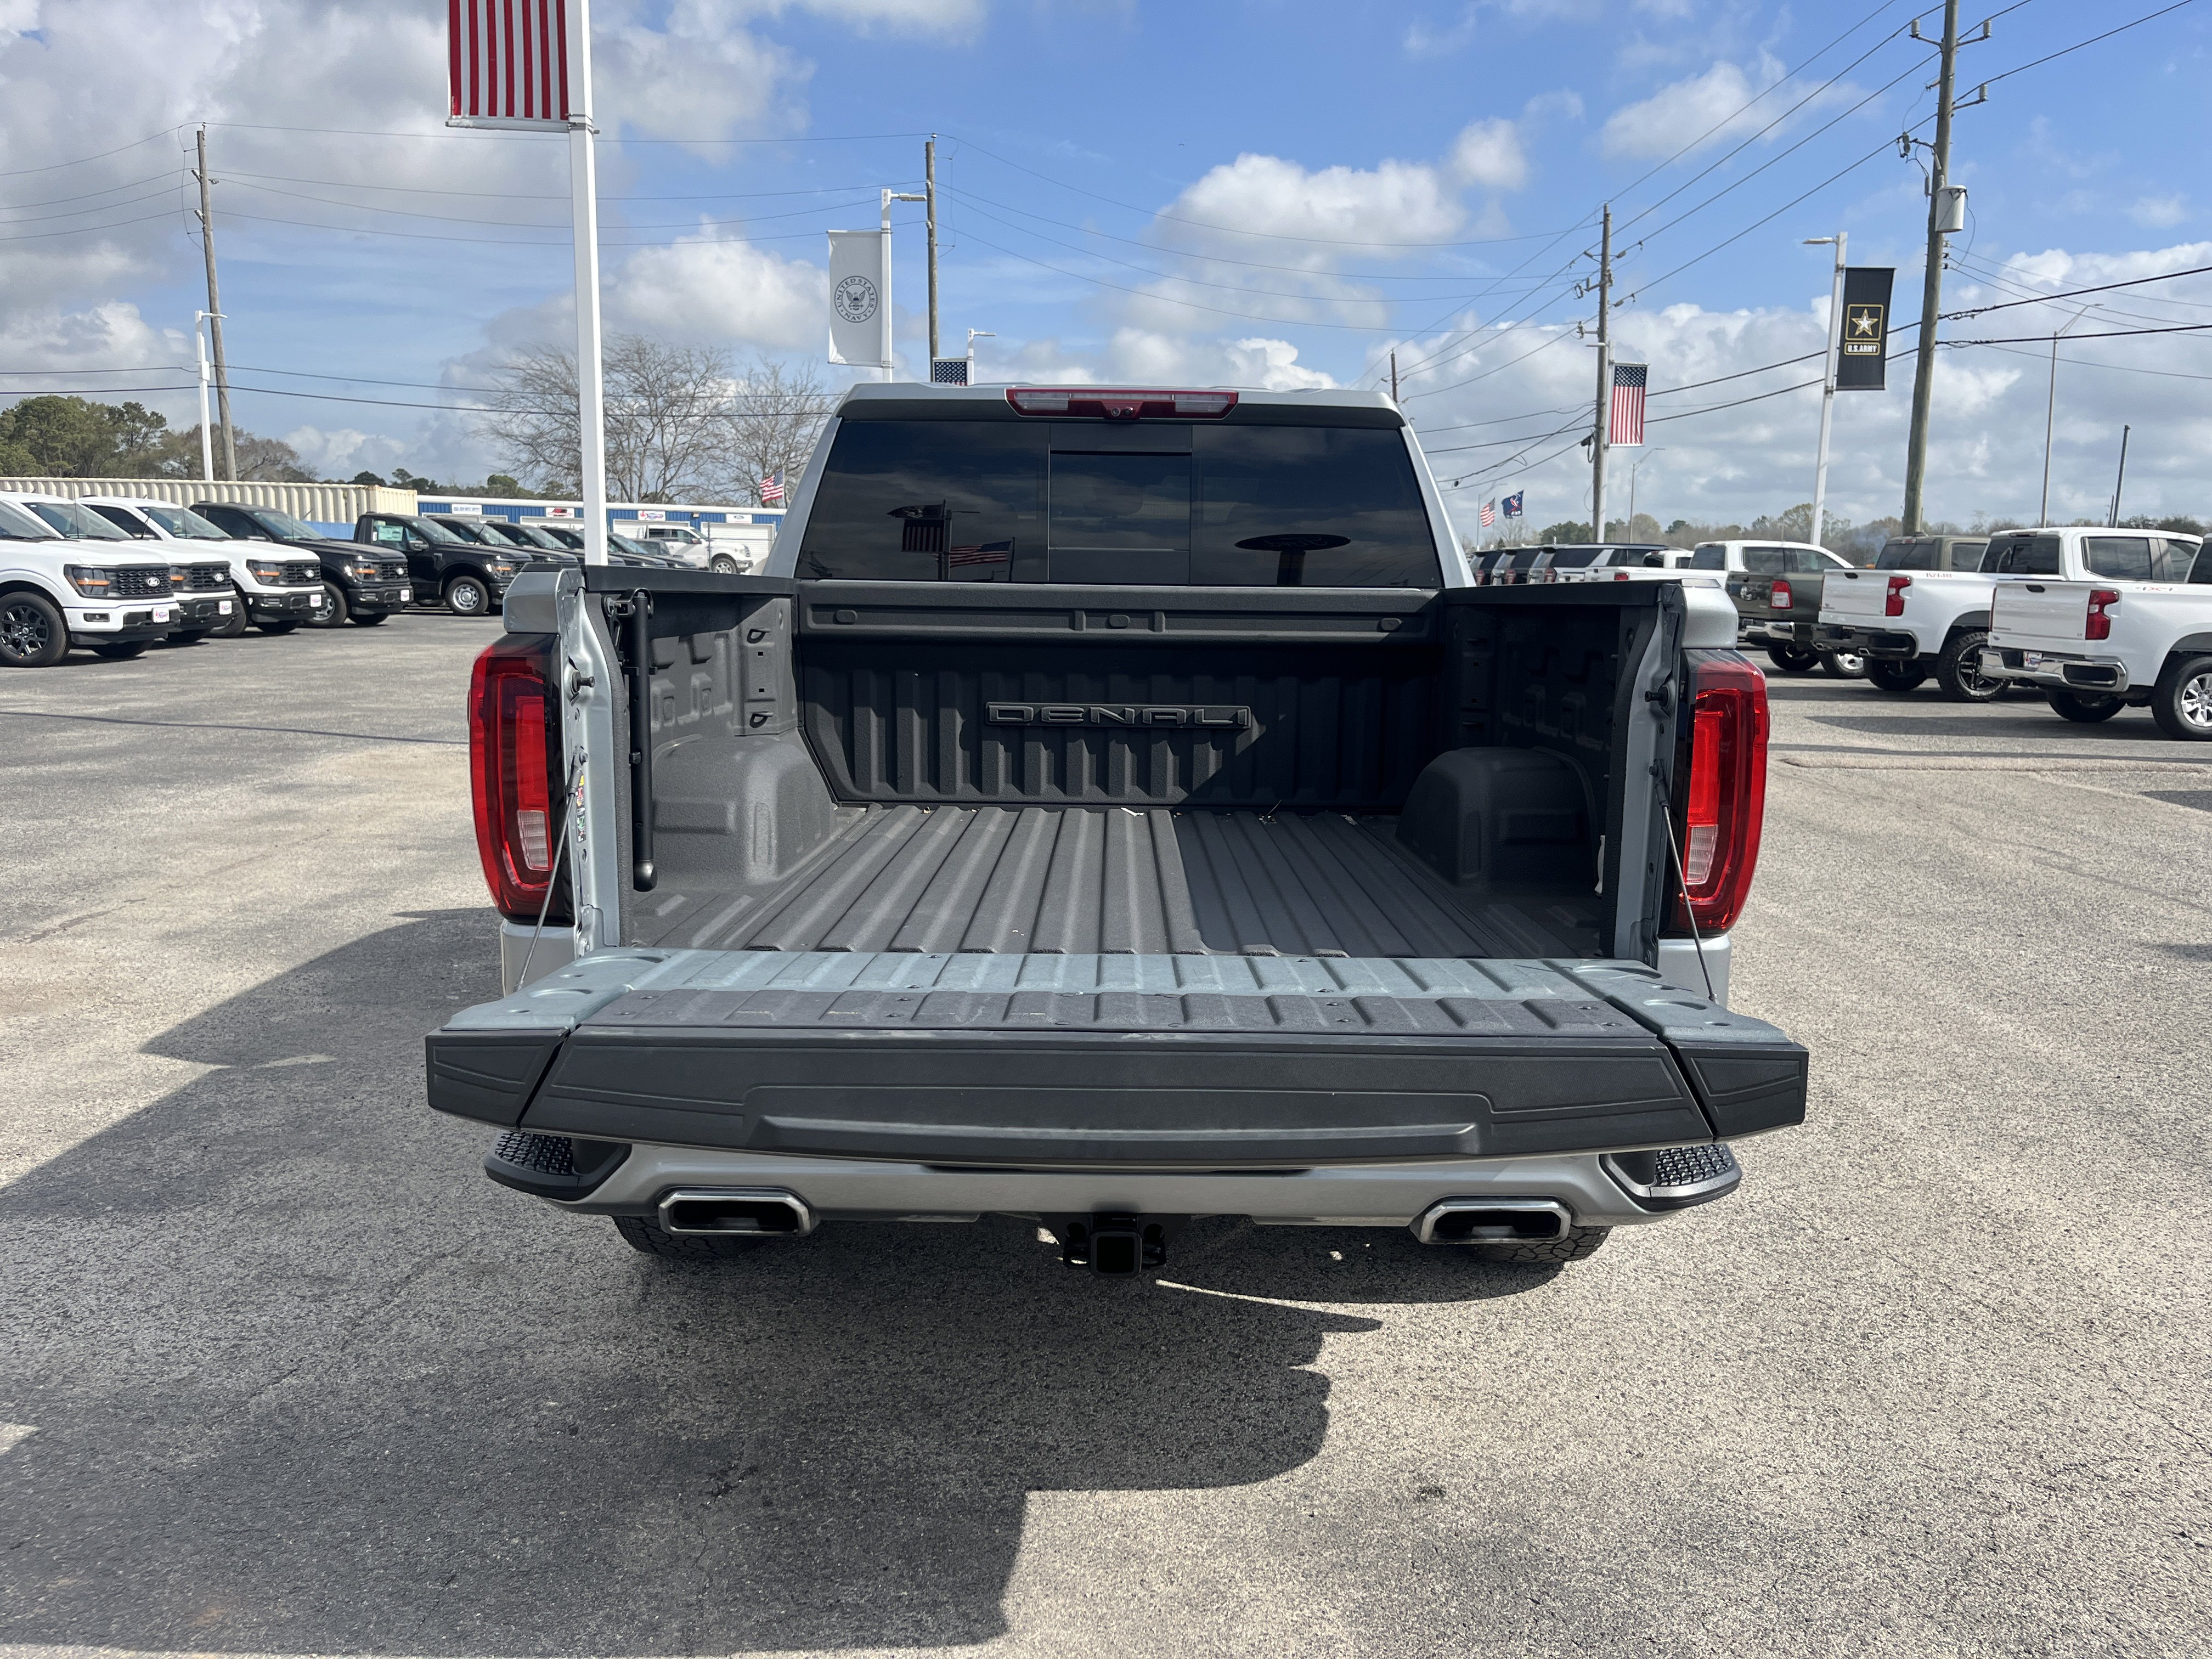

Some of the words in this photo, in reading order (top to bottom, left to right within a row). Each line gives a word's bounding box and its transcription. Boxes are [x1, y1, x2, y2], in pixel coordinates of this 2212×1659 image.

[837, 279, 856, 308] UNITED
[857, 279, 875, 308] STATES
[988, 705, 1248, 726] DENALI
